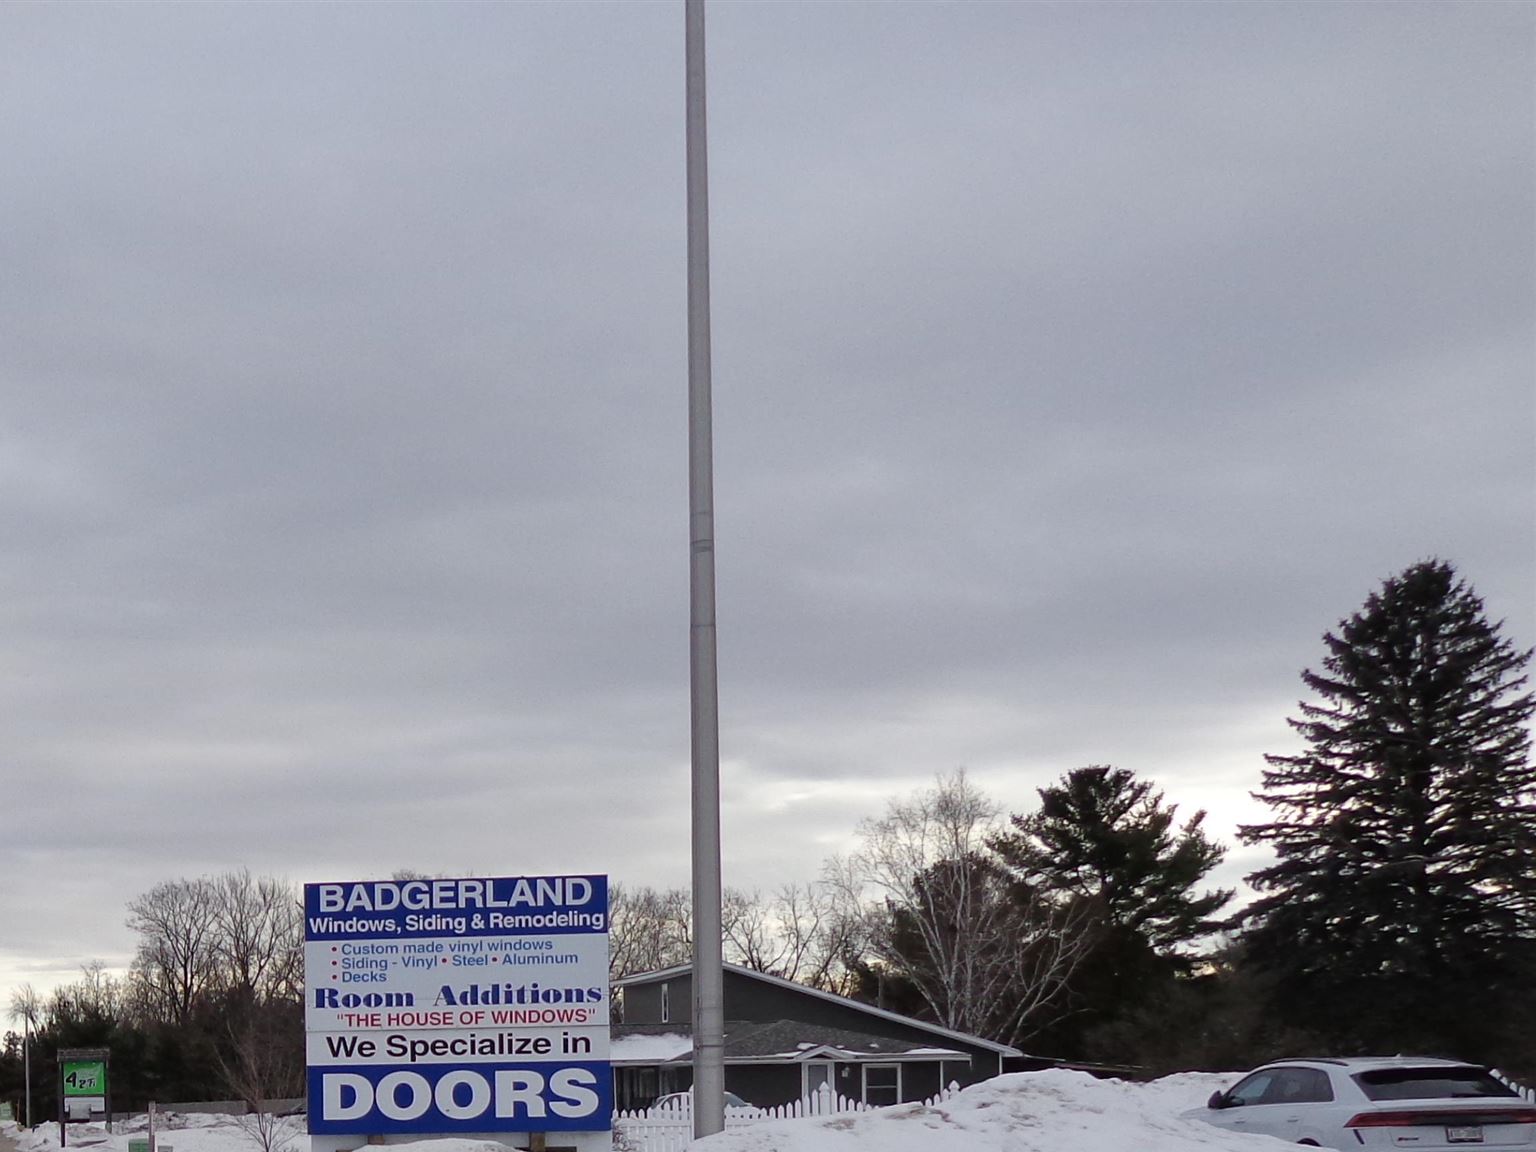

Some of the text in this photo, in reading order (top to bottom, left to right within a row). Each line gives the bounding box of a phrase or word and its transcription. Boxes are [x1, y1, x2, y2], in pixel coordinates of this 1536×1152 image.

[319, 877, 592, 913] BADGERLAND
[309, 911, 604, 935] Windows, Siding & Remodeling
[341, 939, 553, 955] Custom made vinyl windows
[341, 957, 388, 971] Siding
[401, 955, 437, 969] Vinyl
[452, 954, 488, 966] Steel
[502, 952, 578, 965] Aluminum
[342, 971, 387, 983] Decks
[314, 982, 602, 1009] Room Additions
[337, 1008, 596, 1027] "THE HOUSE OF WINDOWS"
[326, 1031, 591, 1062] We Specialize in
[322, 1067, 599, 1121] DOORS
